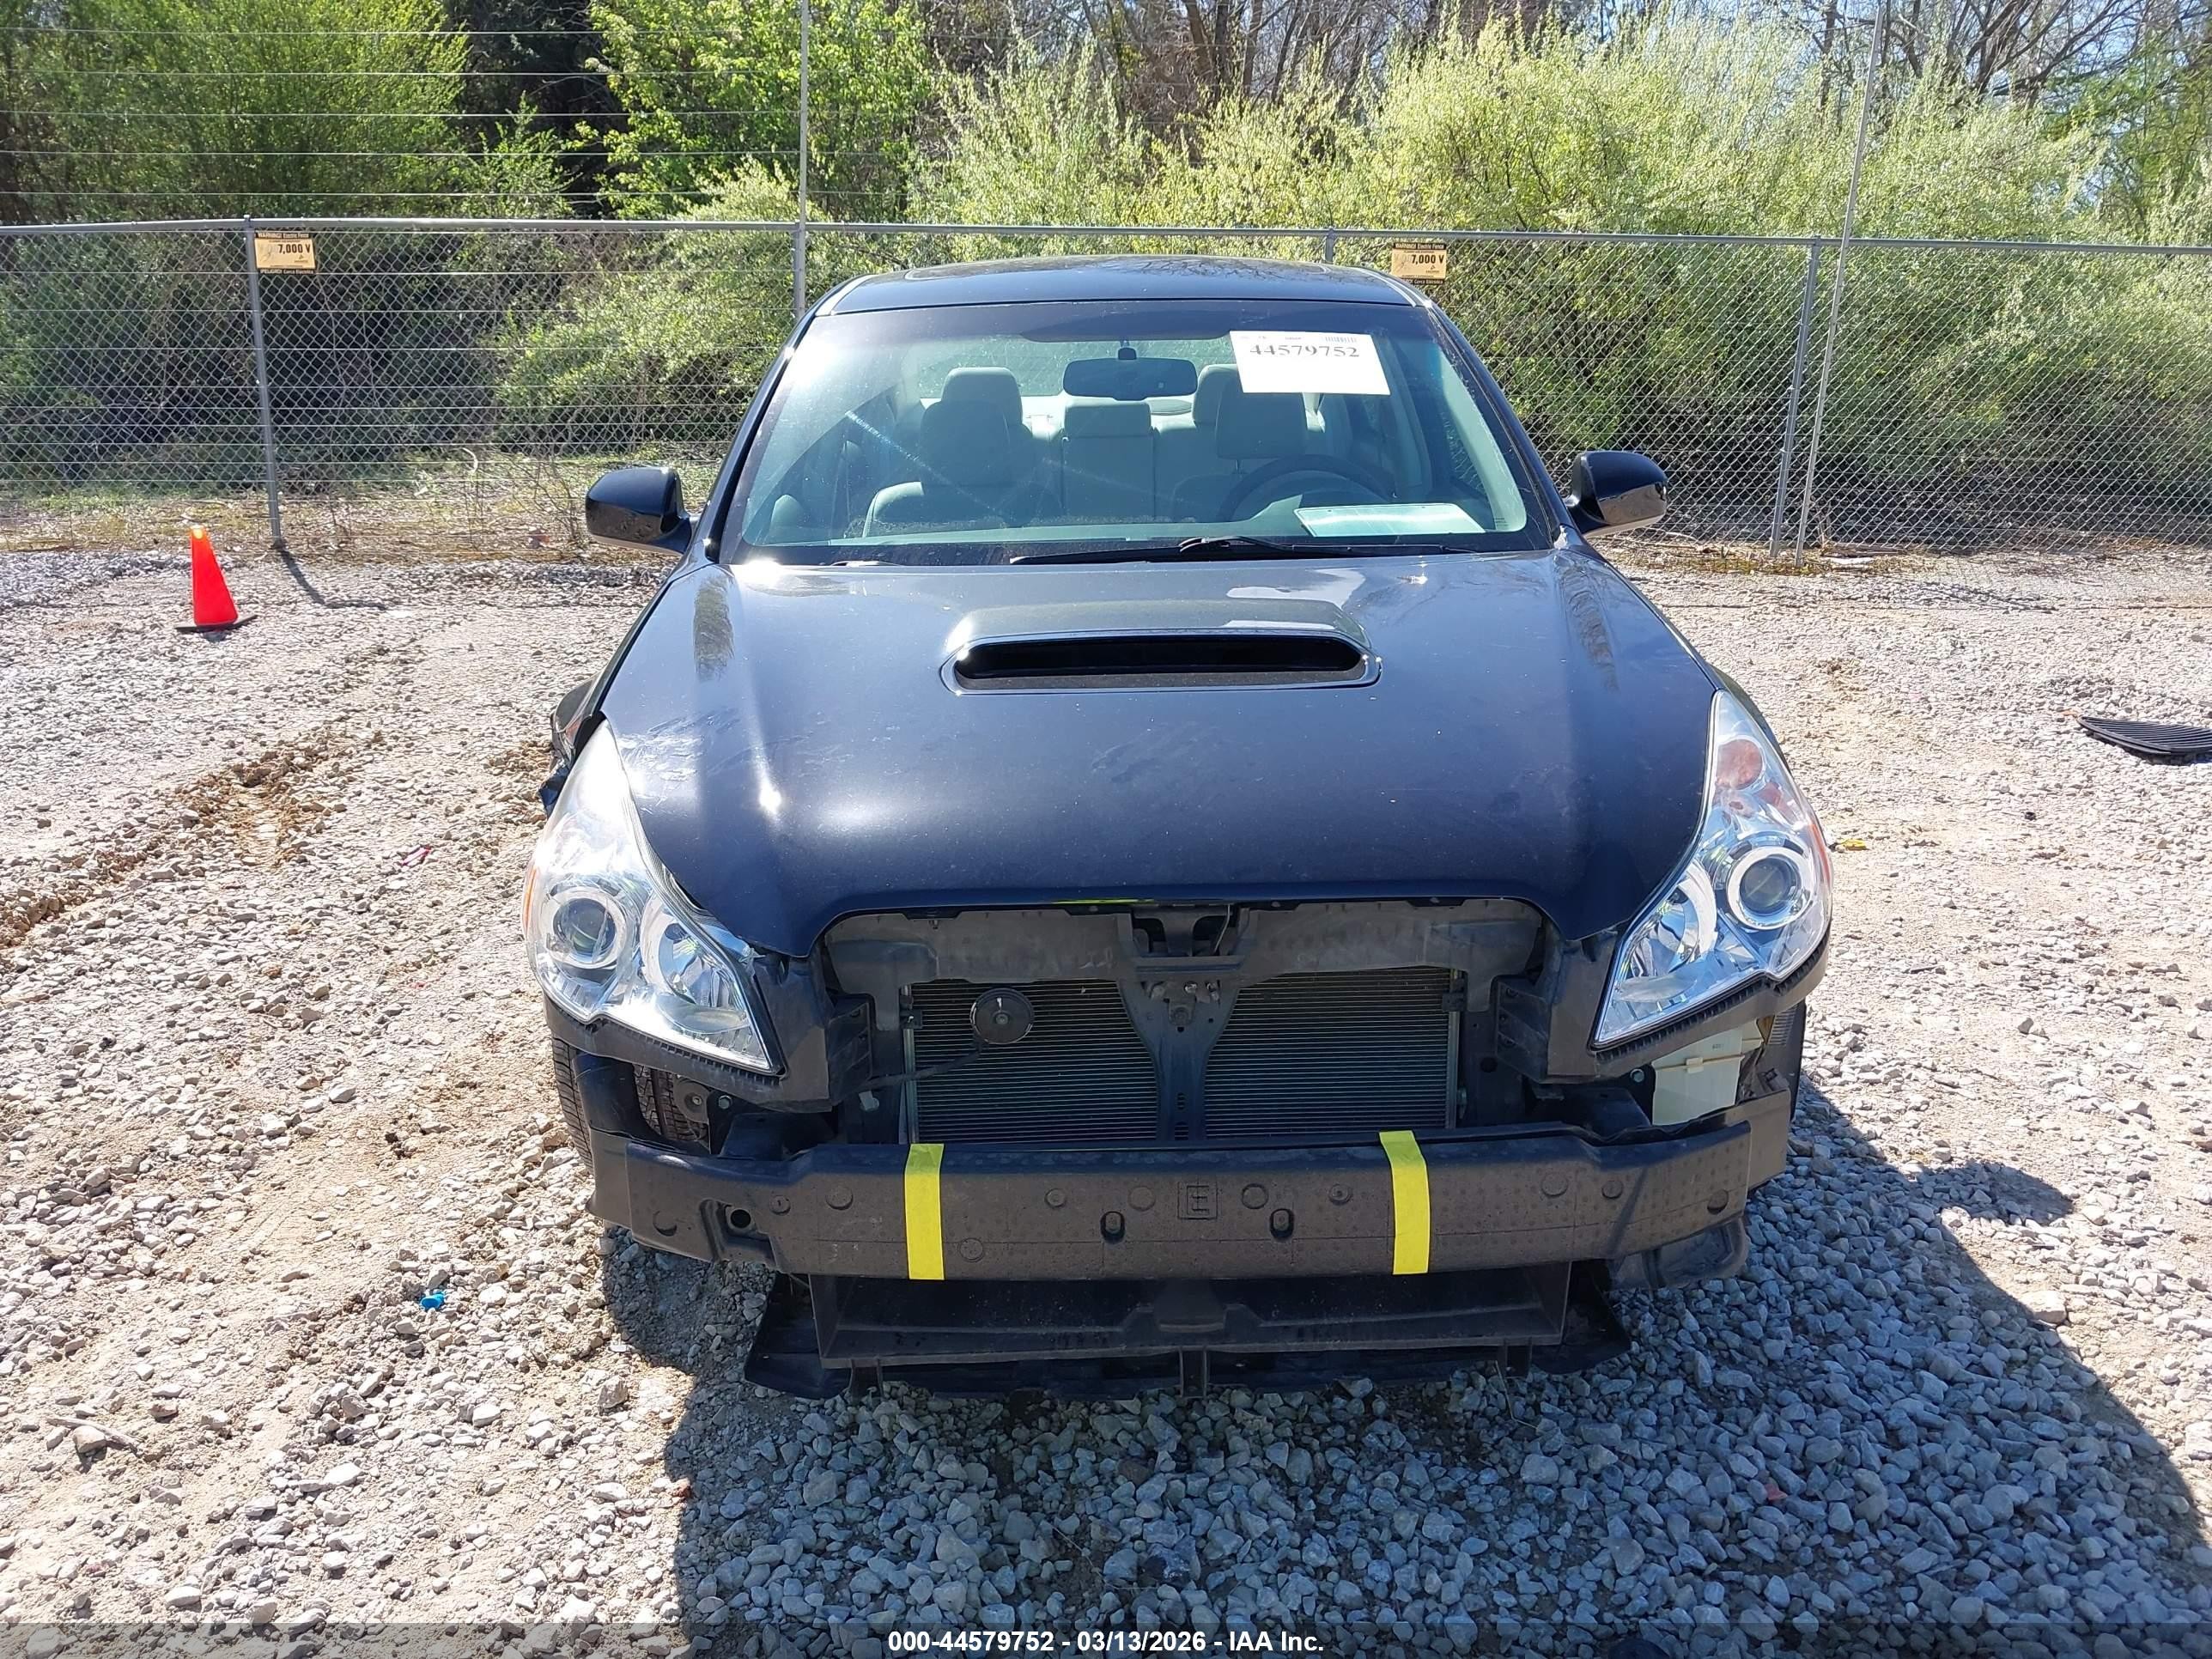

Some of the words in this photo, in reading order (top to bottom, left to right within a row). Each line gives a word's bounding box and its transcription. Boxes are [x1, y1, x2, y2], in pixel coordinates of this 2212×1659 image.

[277, 244, 303, 254] 7,000
[305, 244, 311, 253] V
[1411, 254, 1436, 264] 7,000
[1438, 254, 1444, 264] V
[1249, 344, 1360, 358] 44579752
